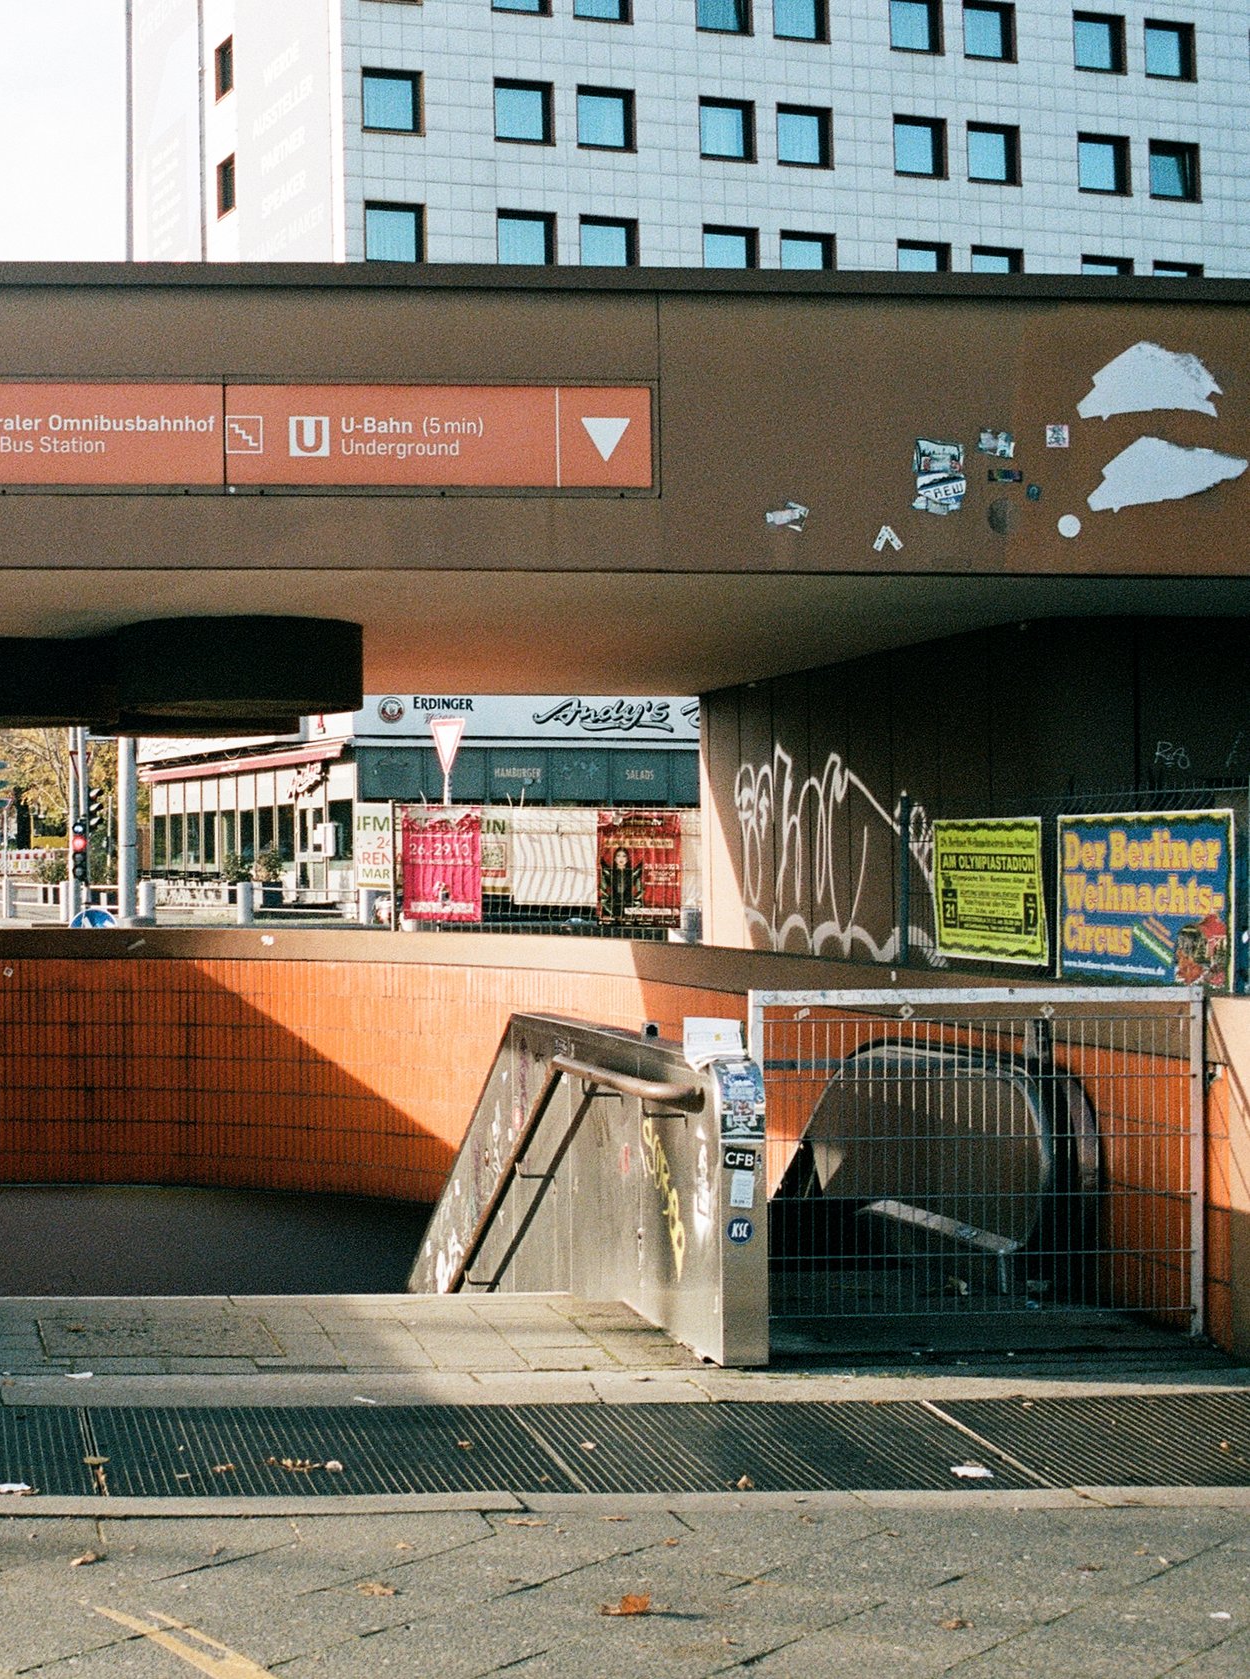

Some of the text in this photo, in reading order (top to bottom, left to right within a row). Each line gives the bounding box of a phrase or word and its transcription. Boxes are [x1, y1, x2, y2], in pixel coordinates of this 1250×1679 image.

[261, 126, 306, 176] PARTNER
[261, 170, 307, 219] SPEAKER
[289, 203, 325, 246] MAKER
[48, 414, 215, 433] Omnibusbahnhof
[341, 416, 413, 434] U-Bahn
[0, 436, 34, 453] Bus
[39, 436, 106, 453] Station
[295, 418, 324, 454] U
[341, 438, 460, 459] Underground
[413, 696, 474, 711] ERDINGER
[533, 697, 674, 733] Andy's
[494, 768, 542, 779] HAMBURGER
[626, 769, 655, 780] SALADS
[1064, 829, 1221, 871] Der Berliner
[942, 854, 1035, 872] AM OLYMPIASTADION
[1064, 873, 1225, 916] Weihnachts-
[945, 903, 955, 918] 21
[1064, 914, 1132, 956] Circus
[725, 1151, 754, 1167] CFB
[731, 1222, 750, 1238] KSC
